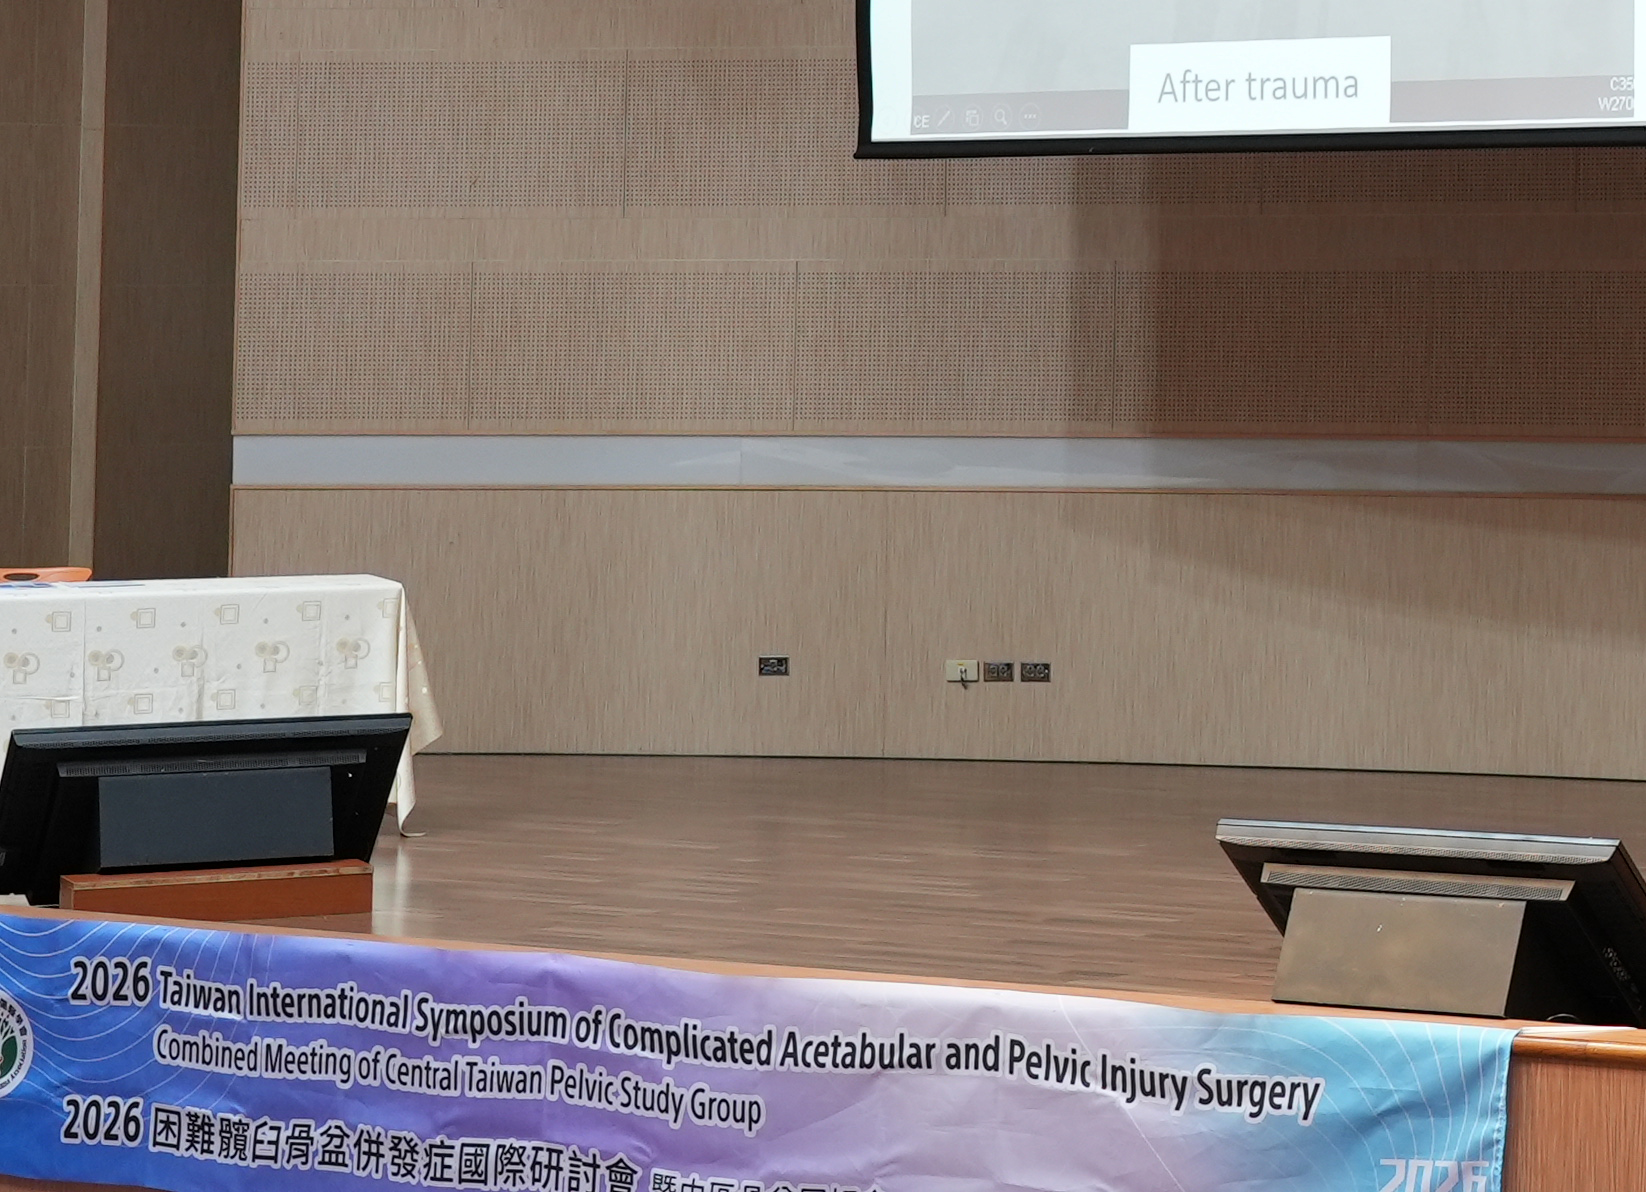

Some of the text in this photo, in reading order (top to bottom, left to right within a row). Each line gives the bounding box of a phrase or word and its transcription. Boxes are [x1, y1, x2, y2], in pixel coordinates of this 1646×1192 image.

[1157, 68, 1359, 104] After trauma
[70, 960, 1321, 1121] 2026 Taiwan International Symposium of Complicated Acetabular and Pelvic Injury Surgery
[156, 1029, 762, 1132] Combined Meeting of Central Taiwan Pelvic Study Group
[63, 1098, 639, 1192] 2026 困難髖臼骨盆併發症國際研討會
